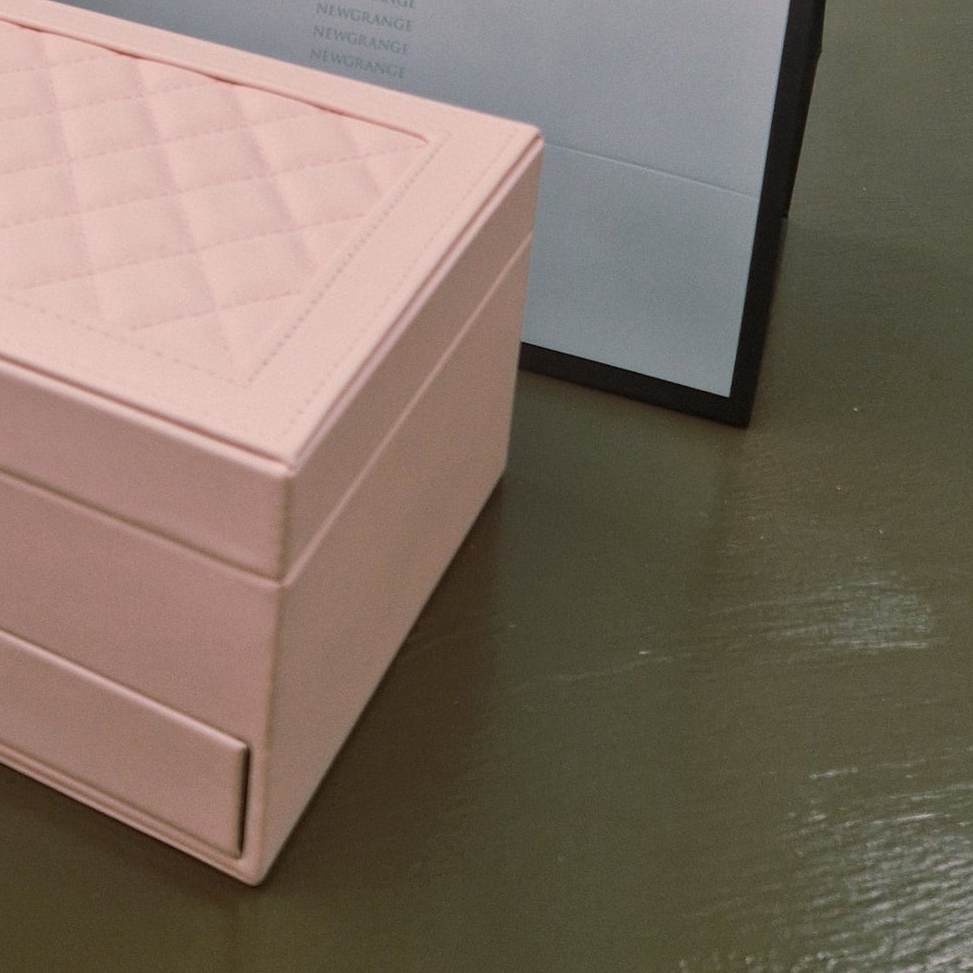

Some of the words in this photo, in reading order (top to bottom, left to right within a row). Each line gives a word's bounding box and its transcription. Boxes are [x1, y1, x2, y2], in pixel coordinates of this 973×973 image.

[315, 3, 413, 32] NEWGRANGE
[312, 25, 410, 55] NEWGRANGE
[309, 49, 406, 77] NEWGRANGE
